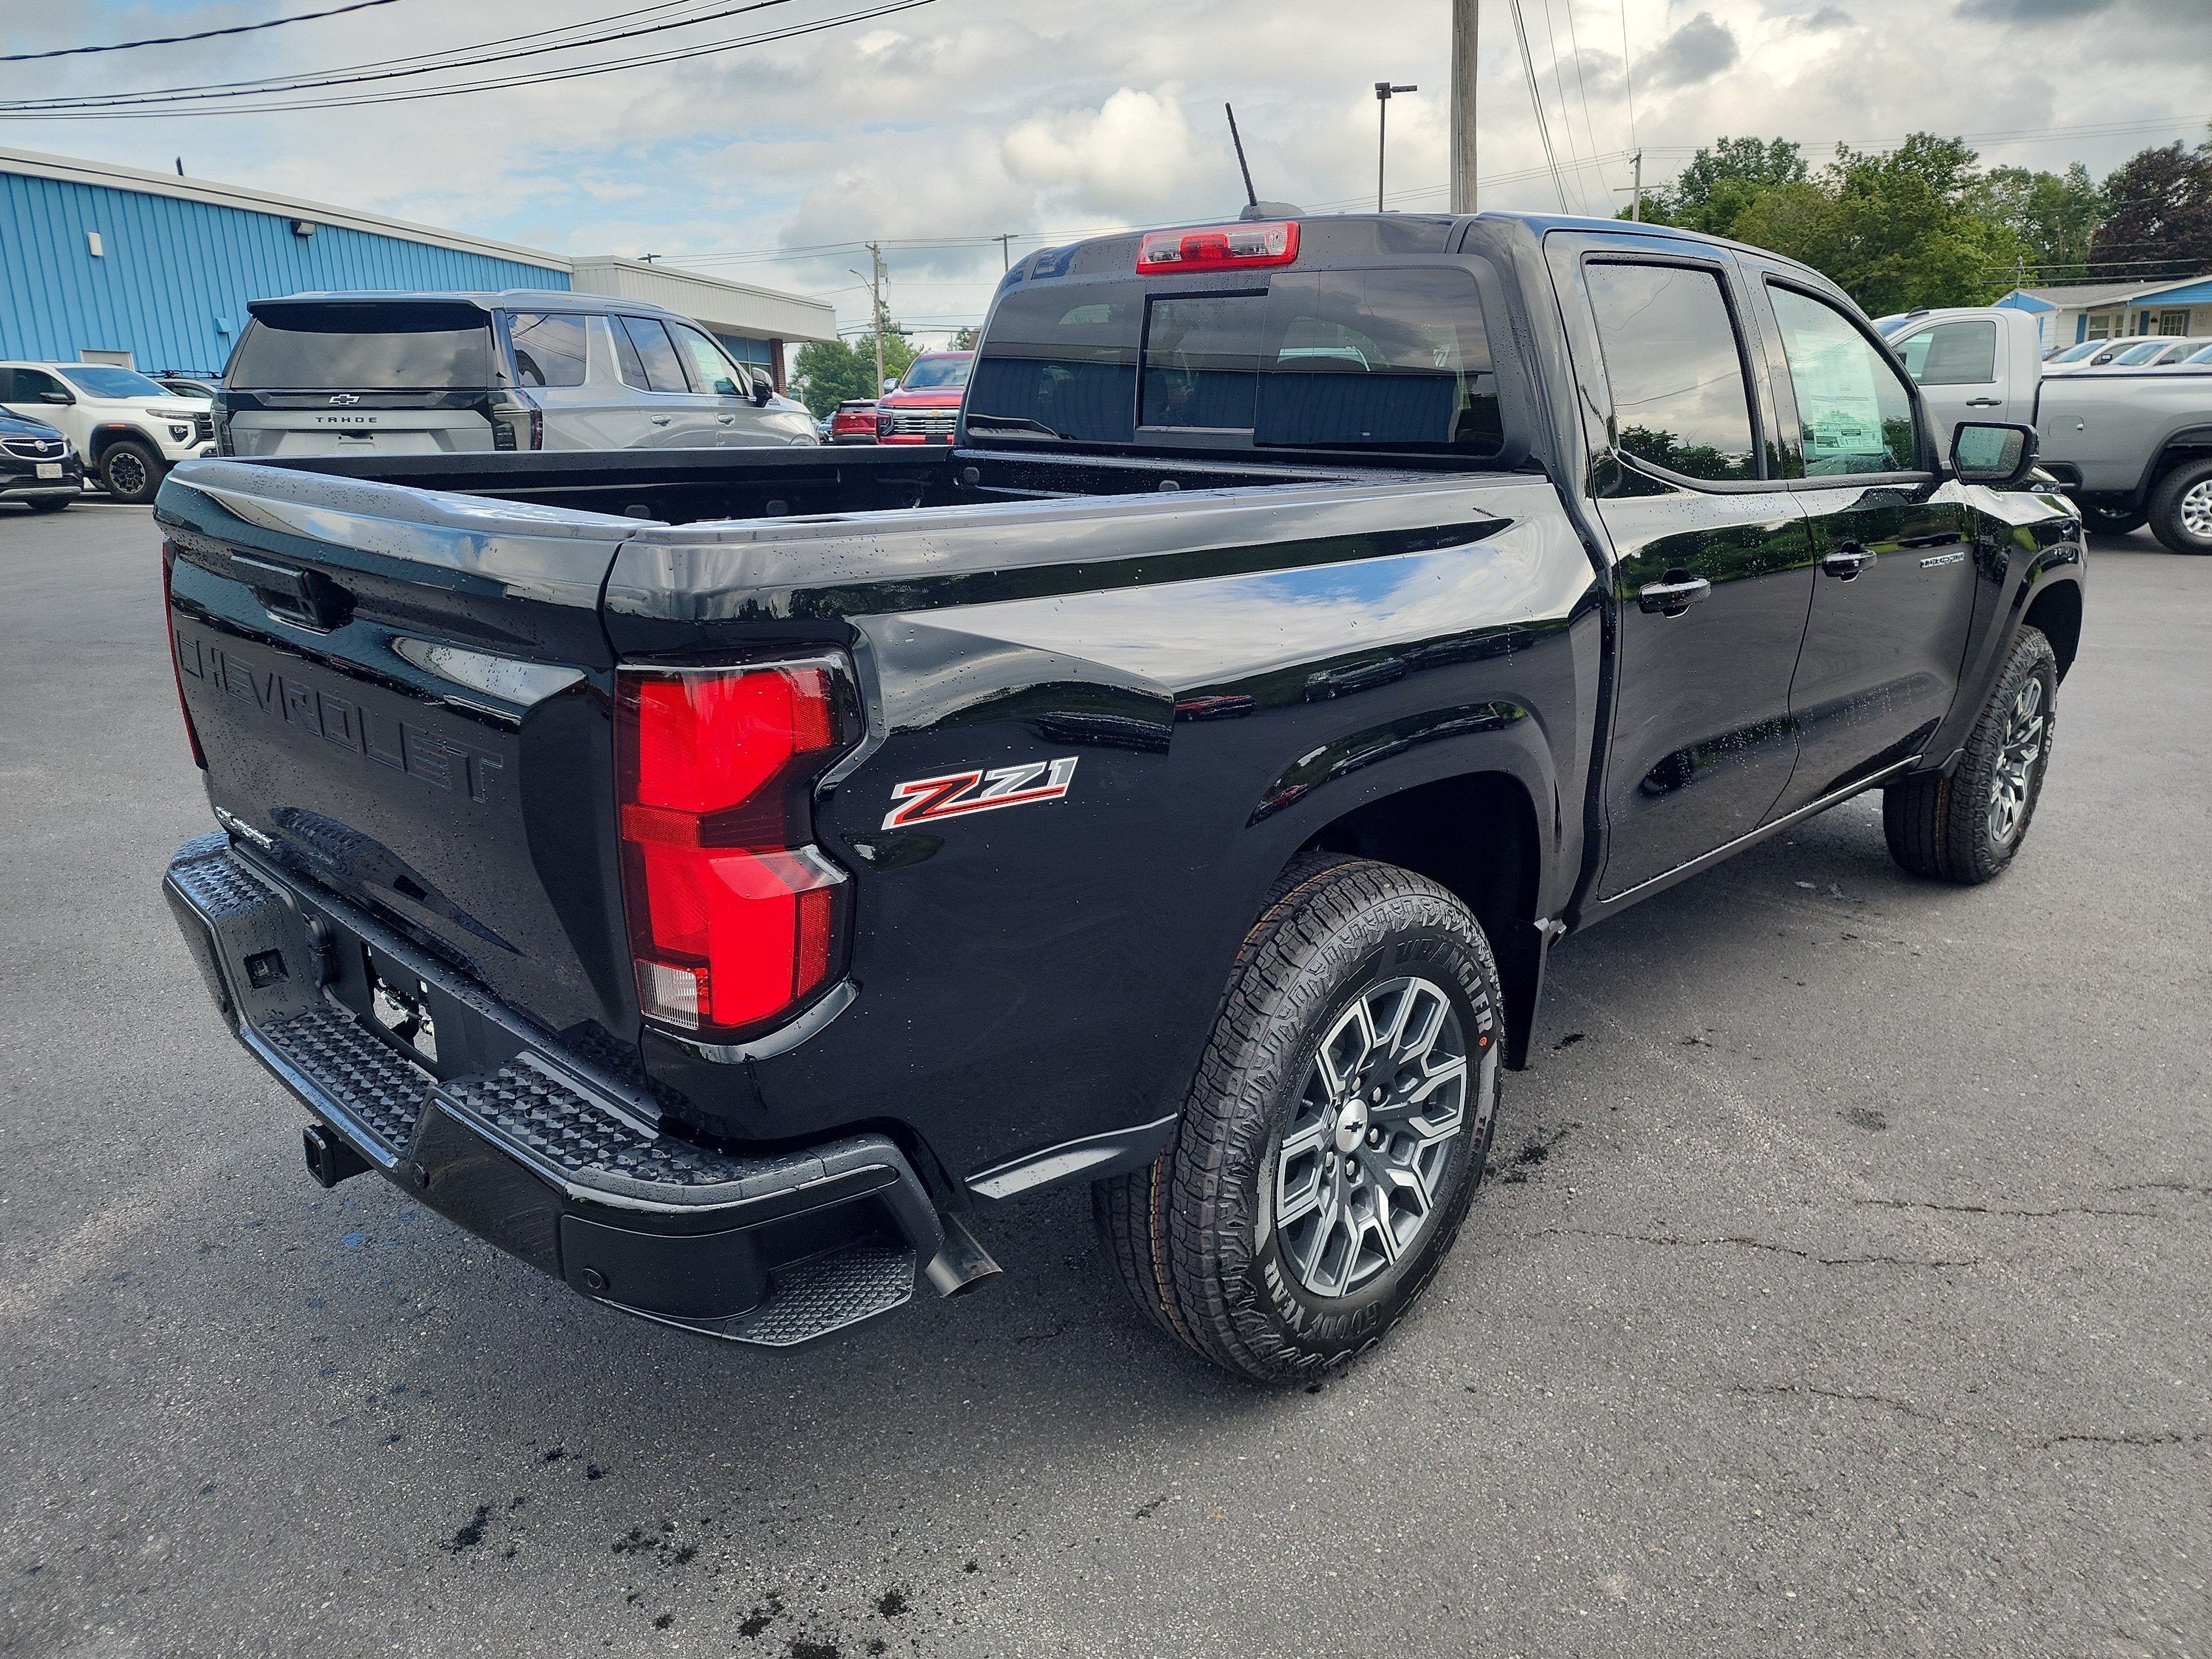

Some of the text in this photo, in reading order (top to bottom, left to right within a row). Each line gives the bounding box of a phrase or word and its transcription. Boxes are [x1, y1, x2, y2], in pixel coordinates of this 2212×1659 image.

[176, 629, 503, 804] CHEVROLET
[880, 755, 1079, 831] Z71
[1395, 938, 1493, 1034] WRANGLER
